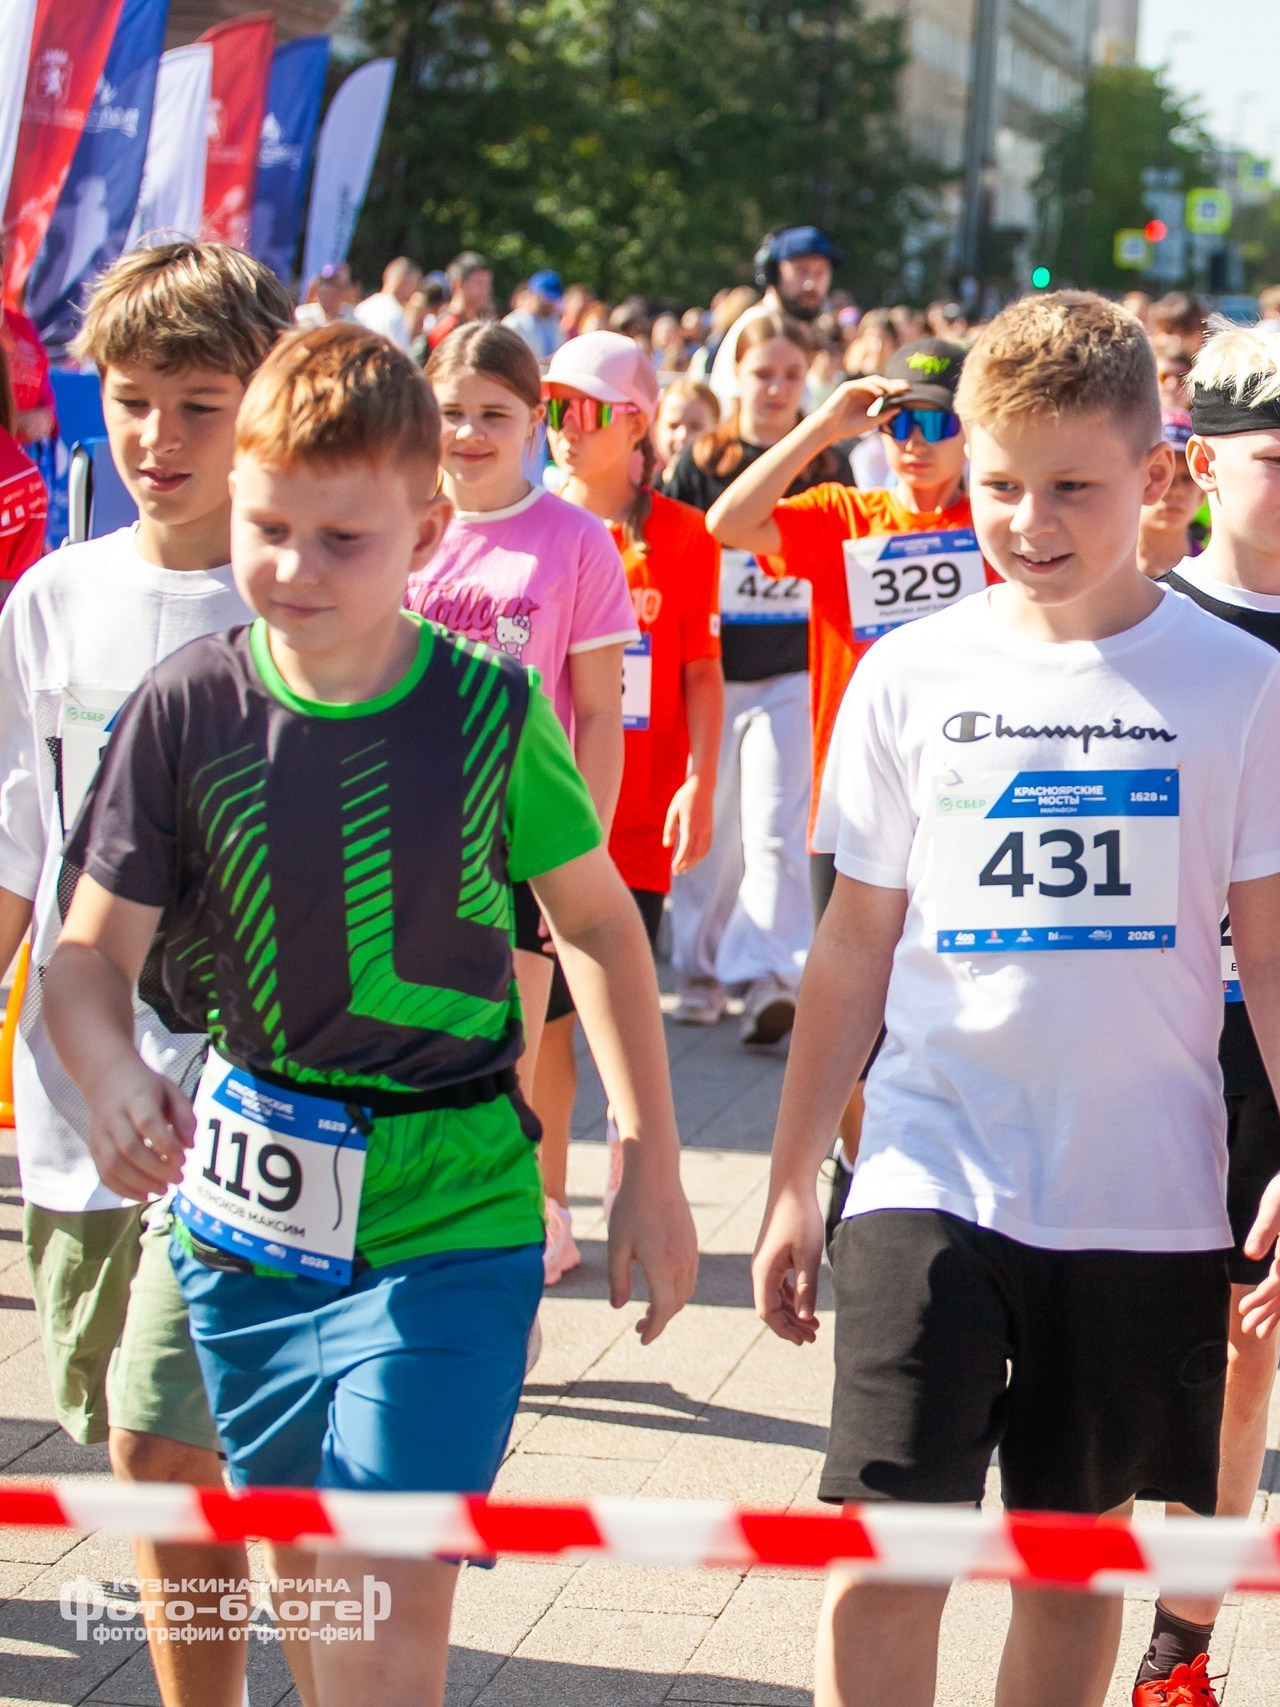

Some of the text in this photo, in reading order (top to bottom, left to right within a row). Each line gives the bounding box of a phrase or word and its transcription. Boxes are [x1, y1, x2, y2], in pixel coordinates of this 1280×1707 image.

[872, 562, 961, 606] 329
[942, 711, 1178, 753] Champion
[1014, 785, 1103, 797] КРАСНОЯРСКИЕ
[1038, 796, 1080, 806] МОСТЫ
[1130, 792, 1157, 802] 1628
[956, 799, 986, 809] СБЕР
[979, 829, 1131, 898] 431
[1128, 931, 1156, 941] 2026
[202, 1118, 303, 1212] 119
[248, 1210, 306, 1238] МАКСИМ
